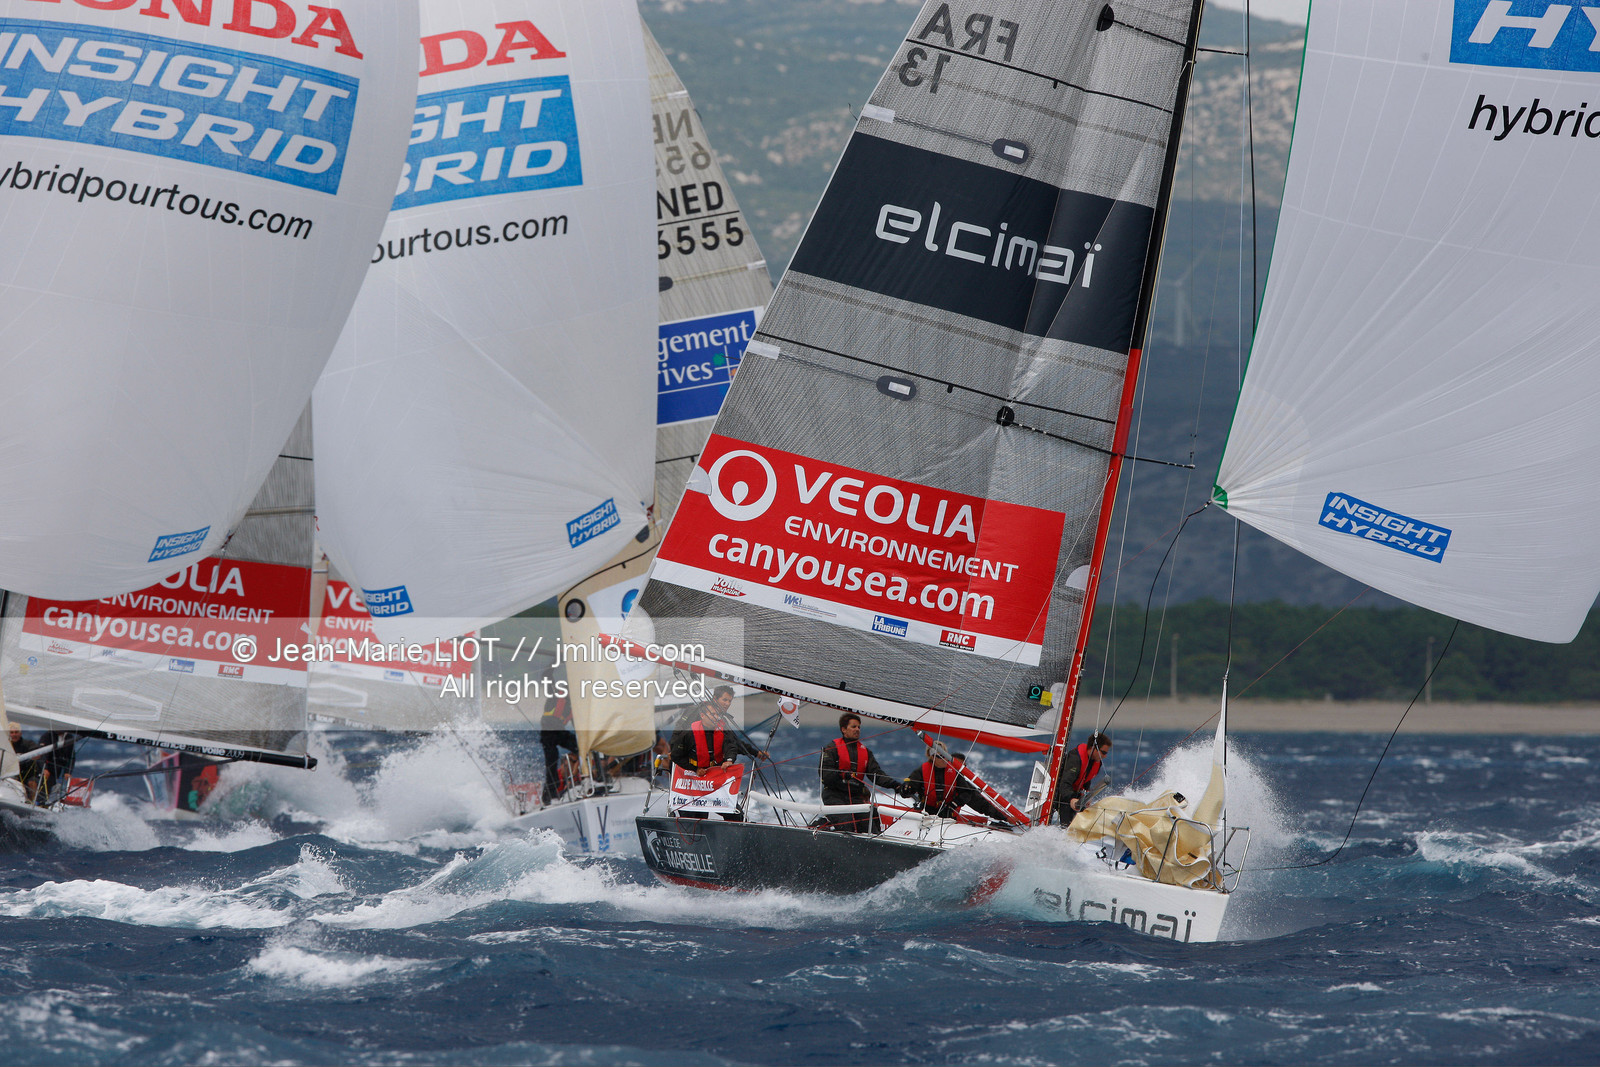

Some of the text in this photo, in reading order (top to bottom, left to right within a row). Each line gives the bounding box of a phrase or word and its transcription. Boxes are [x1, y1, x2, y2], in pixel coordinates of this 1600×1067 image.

[657, 181, 724, 220] NED
[875, 200, 1102, 288] elcimaï
[657, 362, 713, 386] ives
[570, 501, 614, 535] INSIGHT
[794, 464, 976, 543] VEOLIA
[1328, 495, 1448, 543] INSIGHT
[156, 529, 209, 549] INSIGHT
[571, 512, 618, 545] HYBRID
[1323, 511, 1441, 556] HYBRID
[784, 515, 1019, 583] ENVIRONNEMENT
[708, 533, 995, 620] canyousea.com
[43, 606, 257, 655] canyousea.com
[873, 622, 906, 637] TRIBUNE
[874, 616, 885, 625] LA
[946, 632, 970, 646] RMC
[222, 664, 240, 675] RMC
[115, 732, 138, 743] tour
[152, 739, 187, 750] france
[201, 746, 226, 756] voile
[665, 849, 715, 873] MARSEILLE
